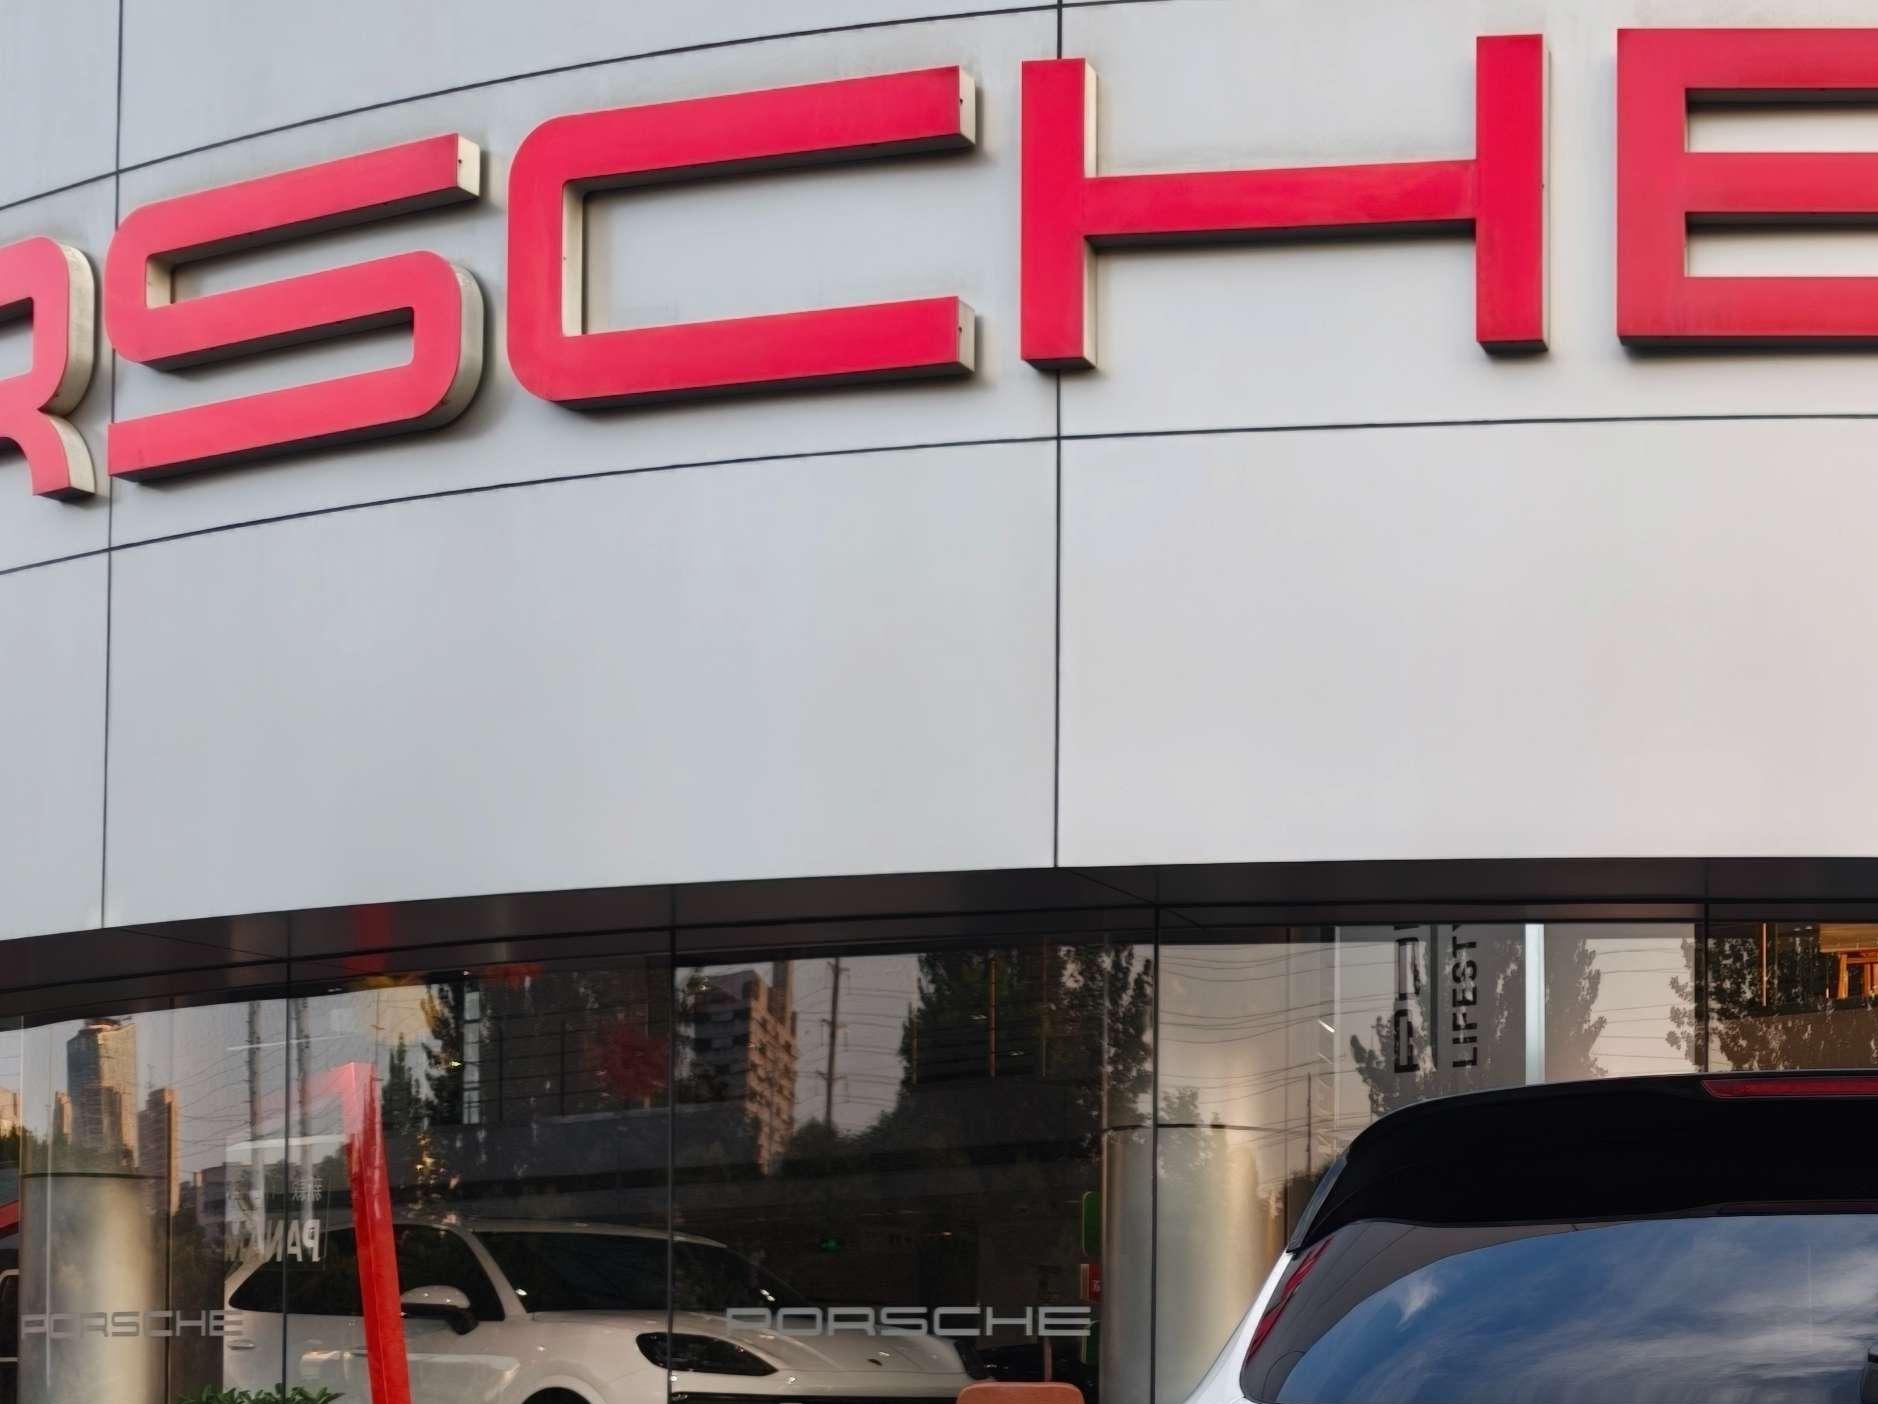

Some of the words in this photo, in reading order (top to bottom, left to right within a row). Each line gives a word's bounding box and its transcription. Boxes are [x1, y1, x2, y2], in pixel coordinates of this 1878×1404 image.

[1452, 924, 1478, 1068] LIFEST
[21, 1309, 243, 1339] PORSCHE
[726, 1306, 1091, 1337] PORSCHE
